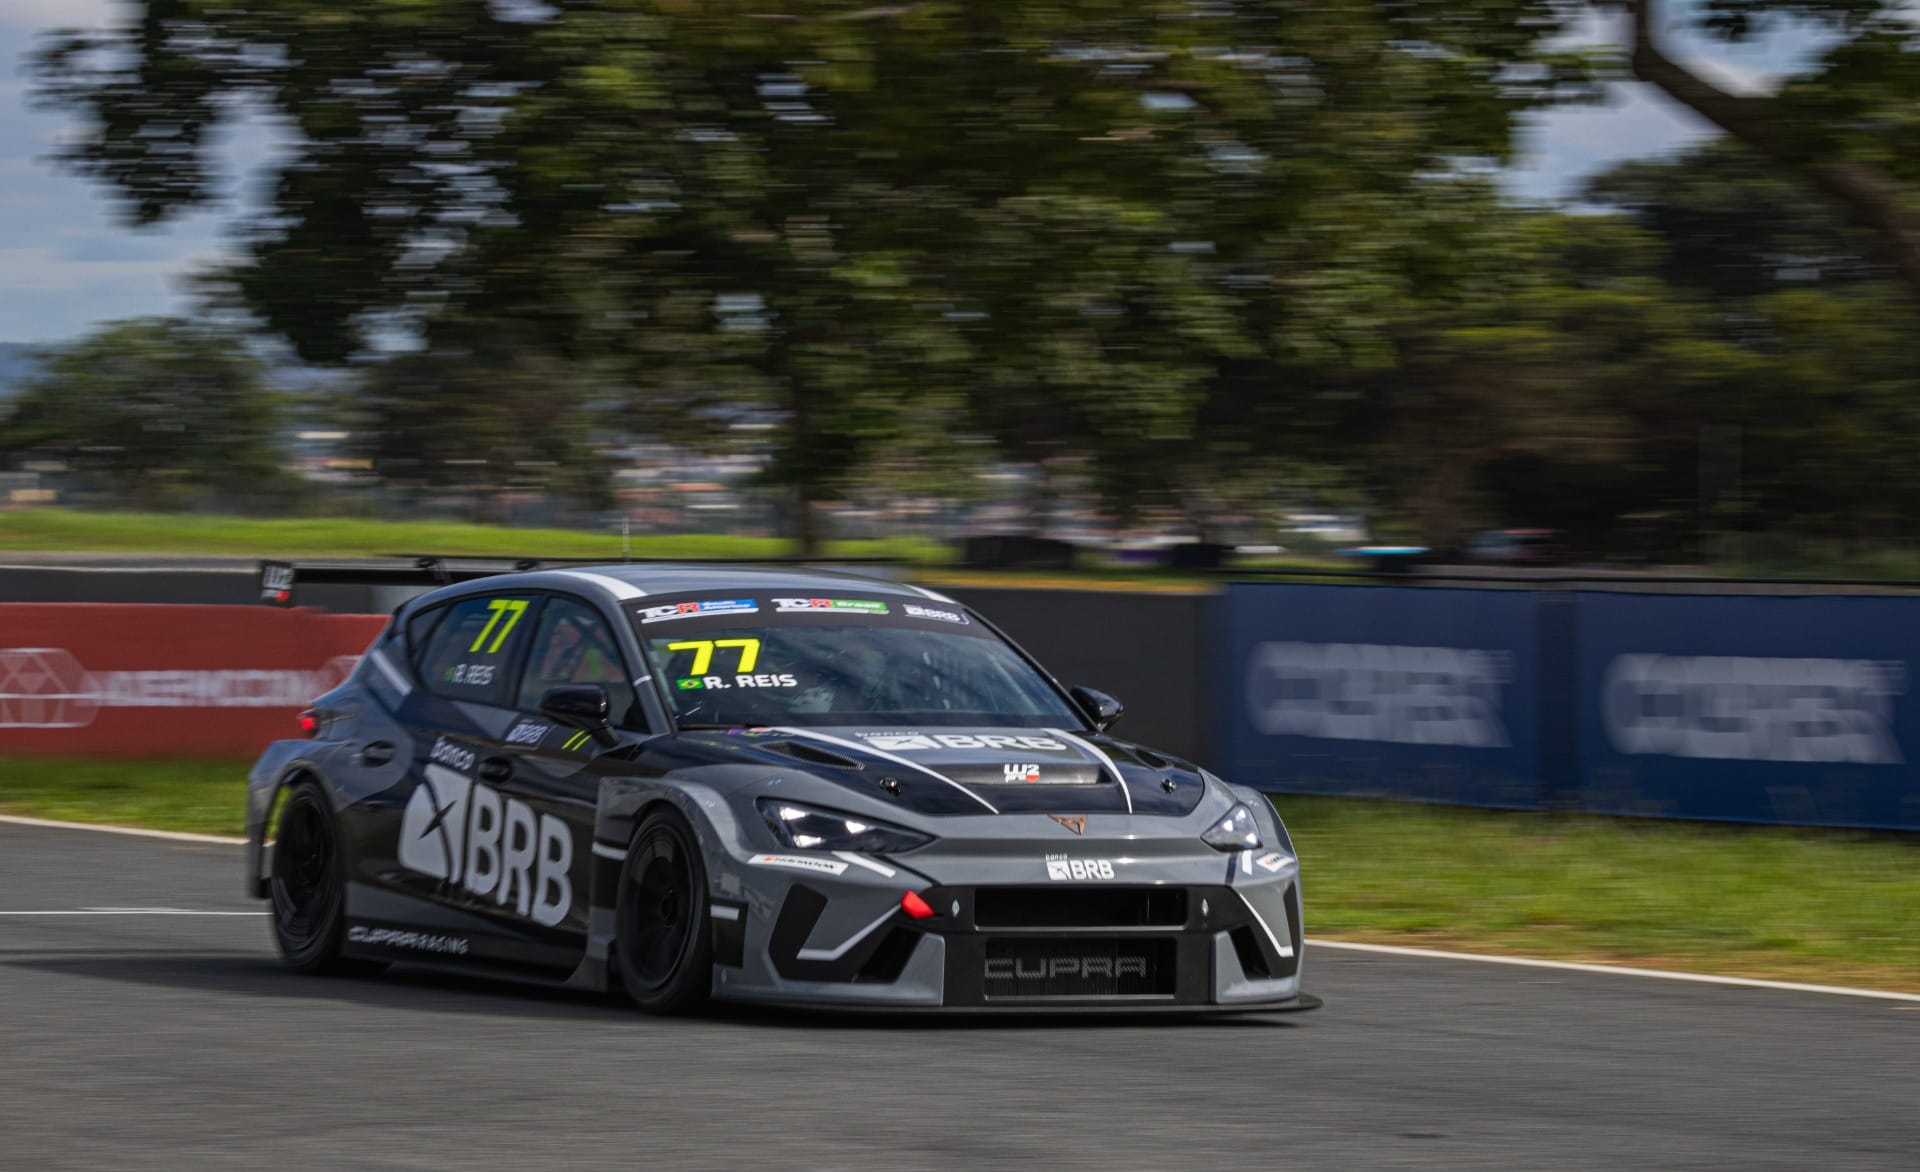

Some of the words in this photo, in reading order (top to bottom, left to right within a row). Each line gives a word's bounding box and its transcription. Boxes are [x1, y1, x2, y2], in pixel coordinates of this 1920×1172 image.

[637, 602, 699, 618] TCR
[469, 599, 530, 654] 77
[667, 638, 760, 676] 77
[702, 676, 731, 689] R.
[735, 674, 797, 688] REIS
[932, 734, 1067, 750] BRB
[463, 783, 574, 927] BRB
[1069, 859, 1115, 880] BRB
[984, 956, 1148, 980] CUPRA
